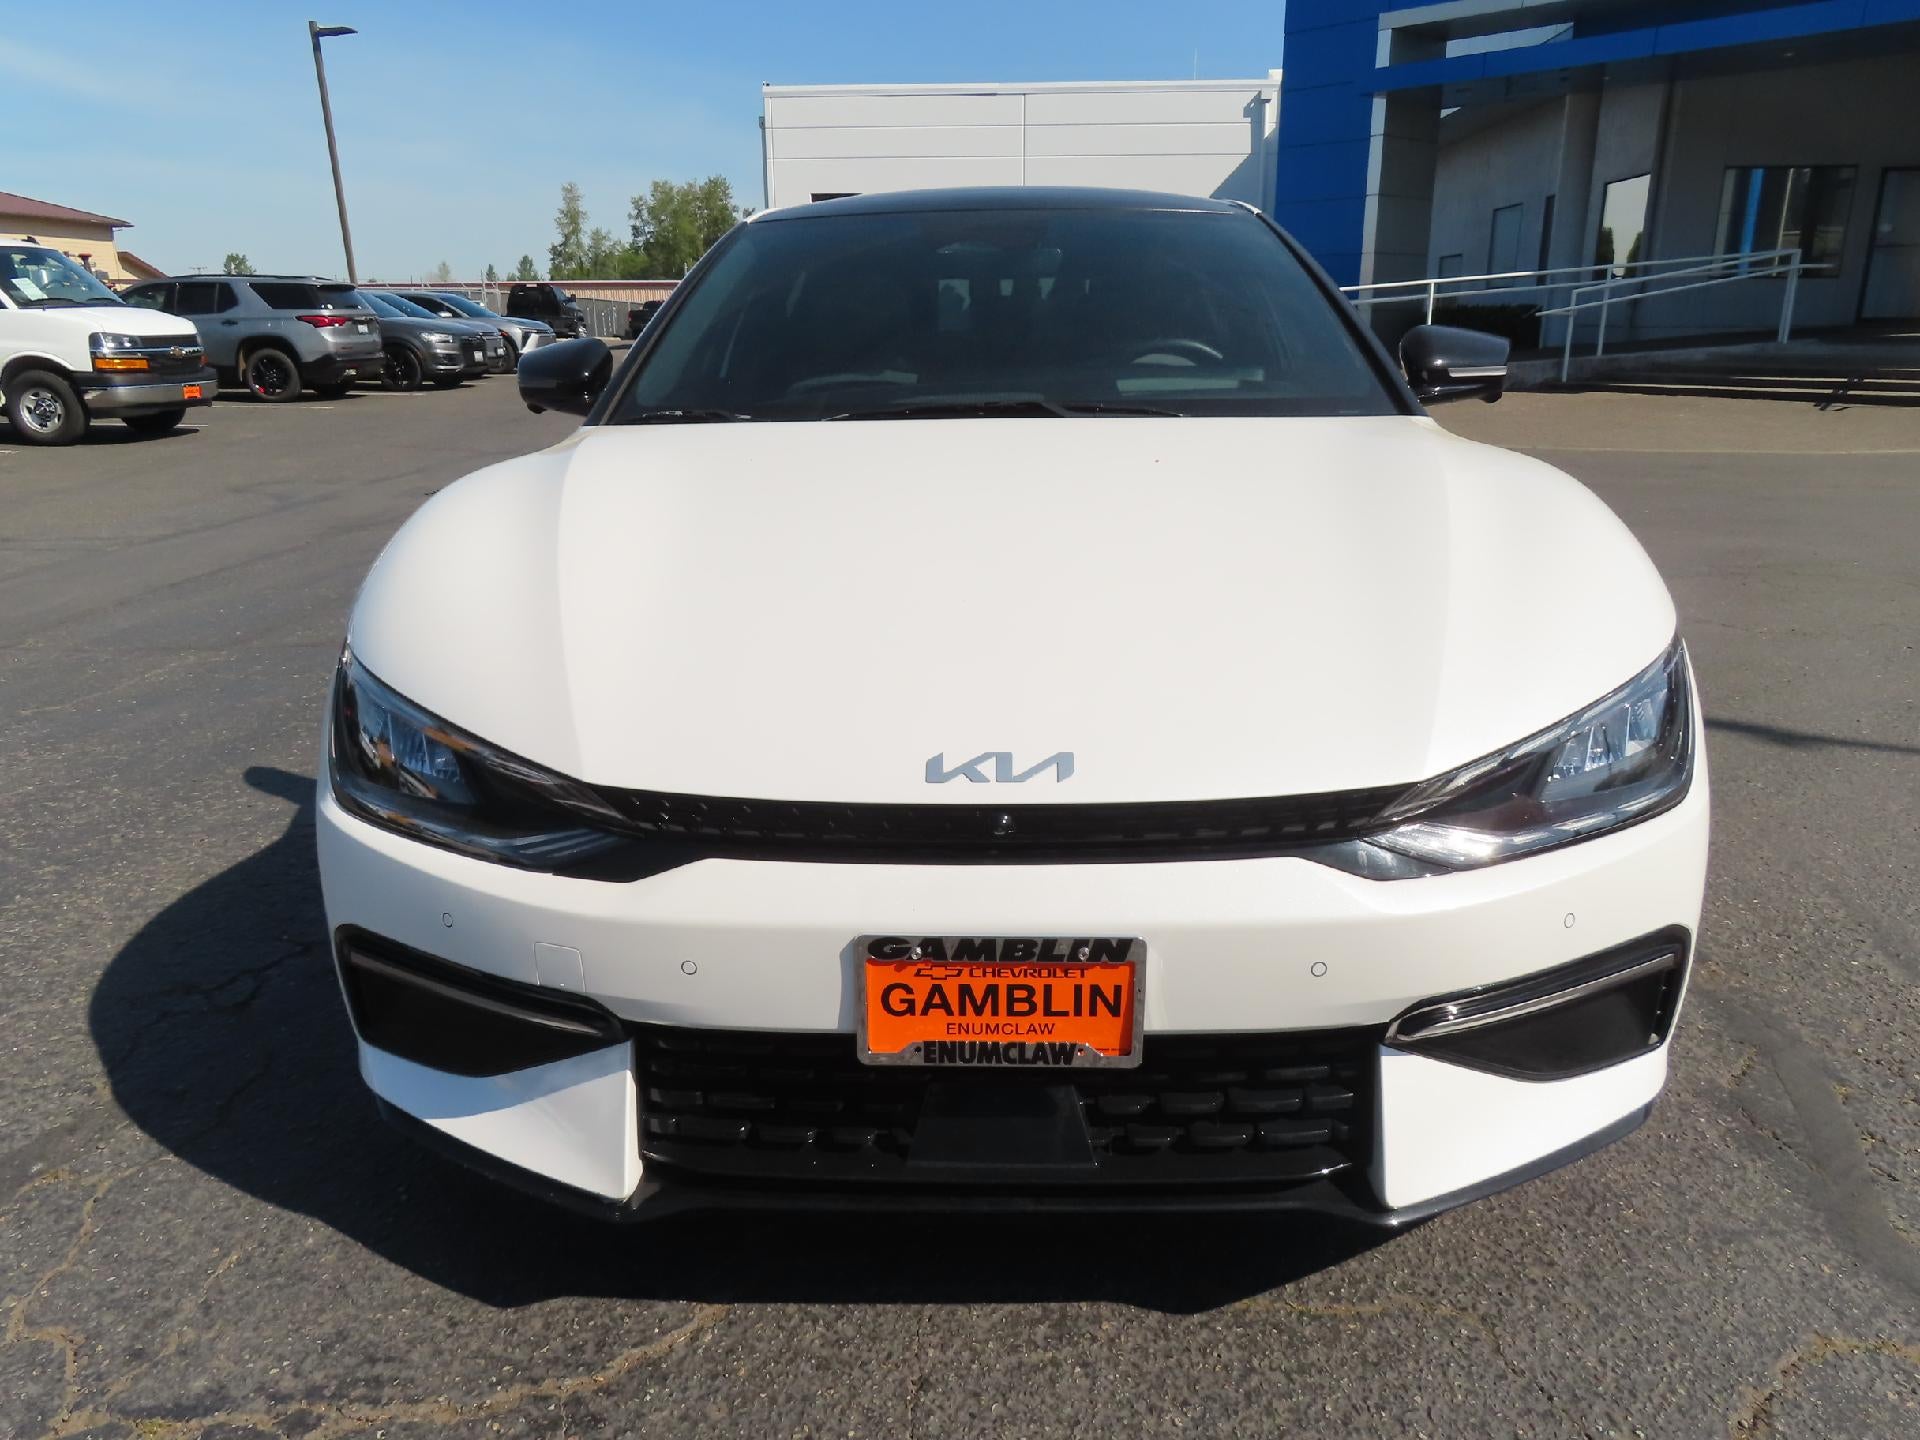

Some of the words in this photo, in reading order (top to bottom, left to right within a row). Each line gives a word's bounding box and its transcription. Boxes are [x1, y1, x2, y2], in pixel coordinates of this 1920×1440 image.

[867, 937, 1133, 962] GAMBLIN
[968, 967, 1088, 979] CHEVROLET
[880, 982, 1122, 1018] GAMBLIN
[946, 1022, 1055, 1035] ENUMCLAW
[923, 1040, 1077, 1065] ENUMCLAW
